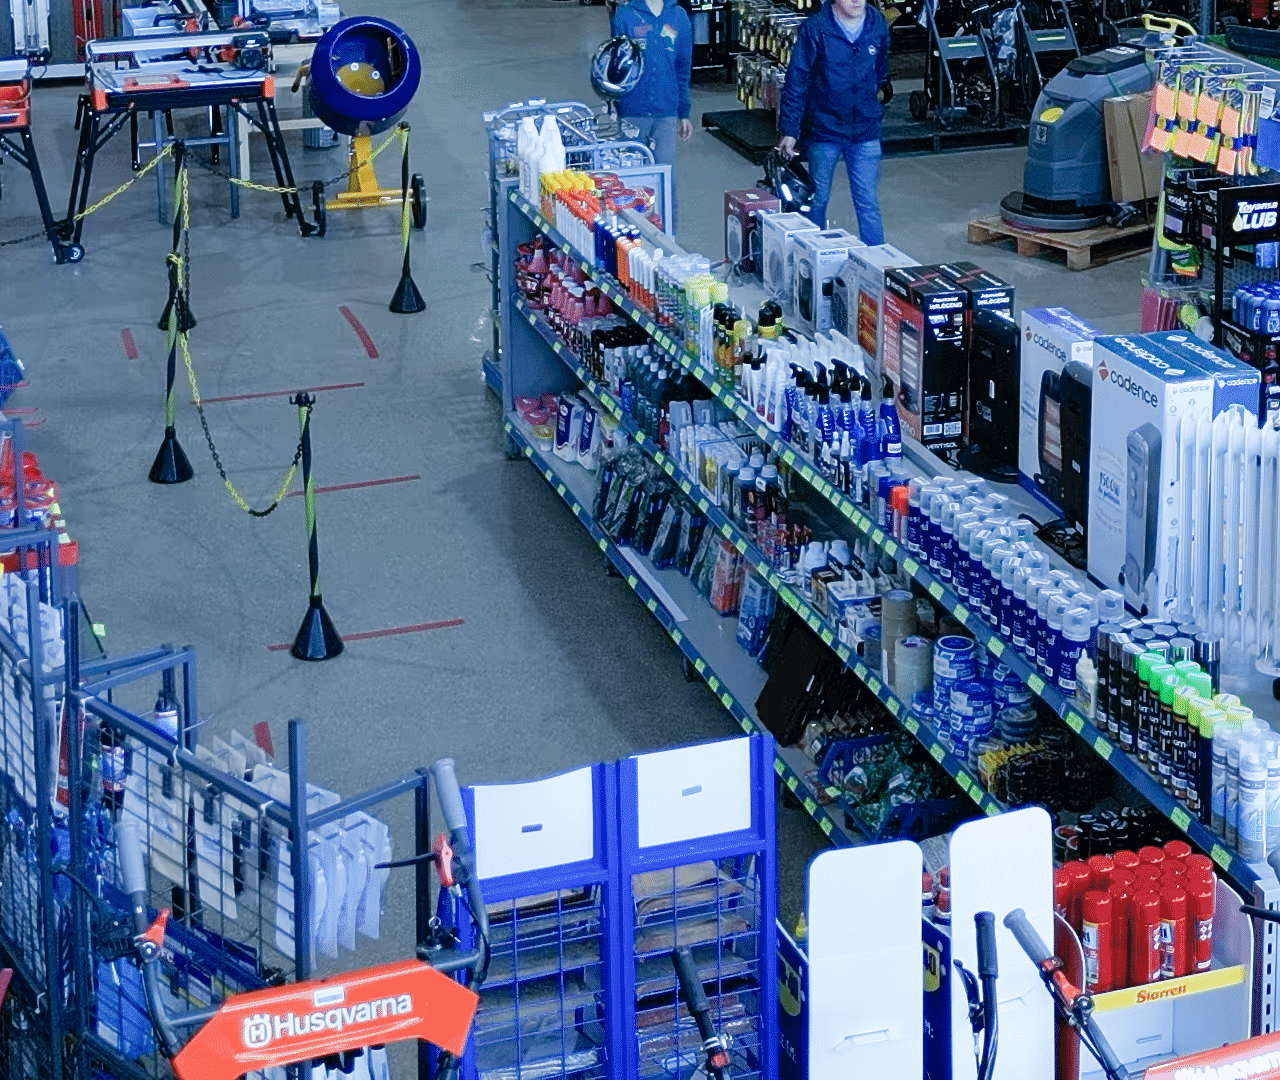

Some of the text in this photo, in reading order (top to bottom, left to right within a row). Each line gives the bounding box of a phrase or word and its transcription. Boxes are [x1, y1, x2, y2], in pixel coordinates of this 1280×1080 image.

[1237, 201, 1279, 213] Toyama
[1242, 212, 1278, 230] LUB
[1033, 333, 1067, 362] cadence
[1114, 337, 1169, 369] cadence
[1181, 342, 1236, 369] cadence
[1110, 369, 1159, 408] cadence
[1137, 984, 1187, 1003] Starrett
[272, 994, 412, 1037] Husqvarna
